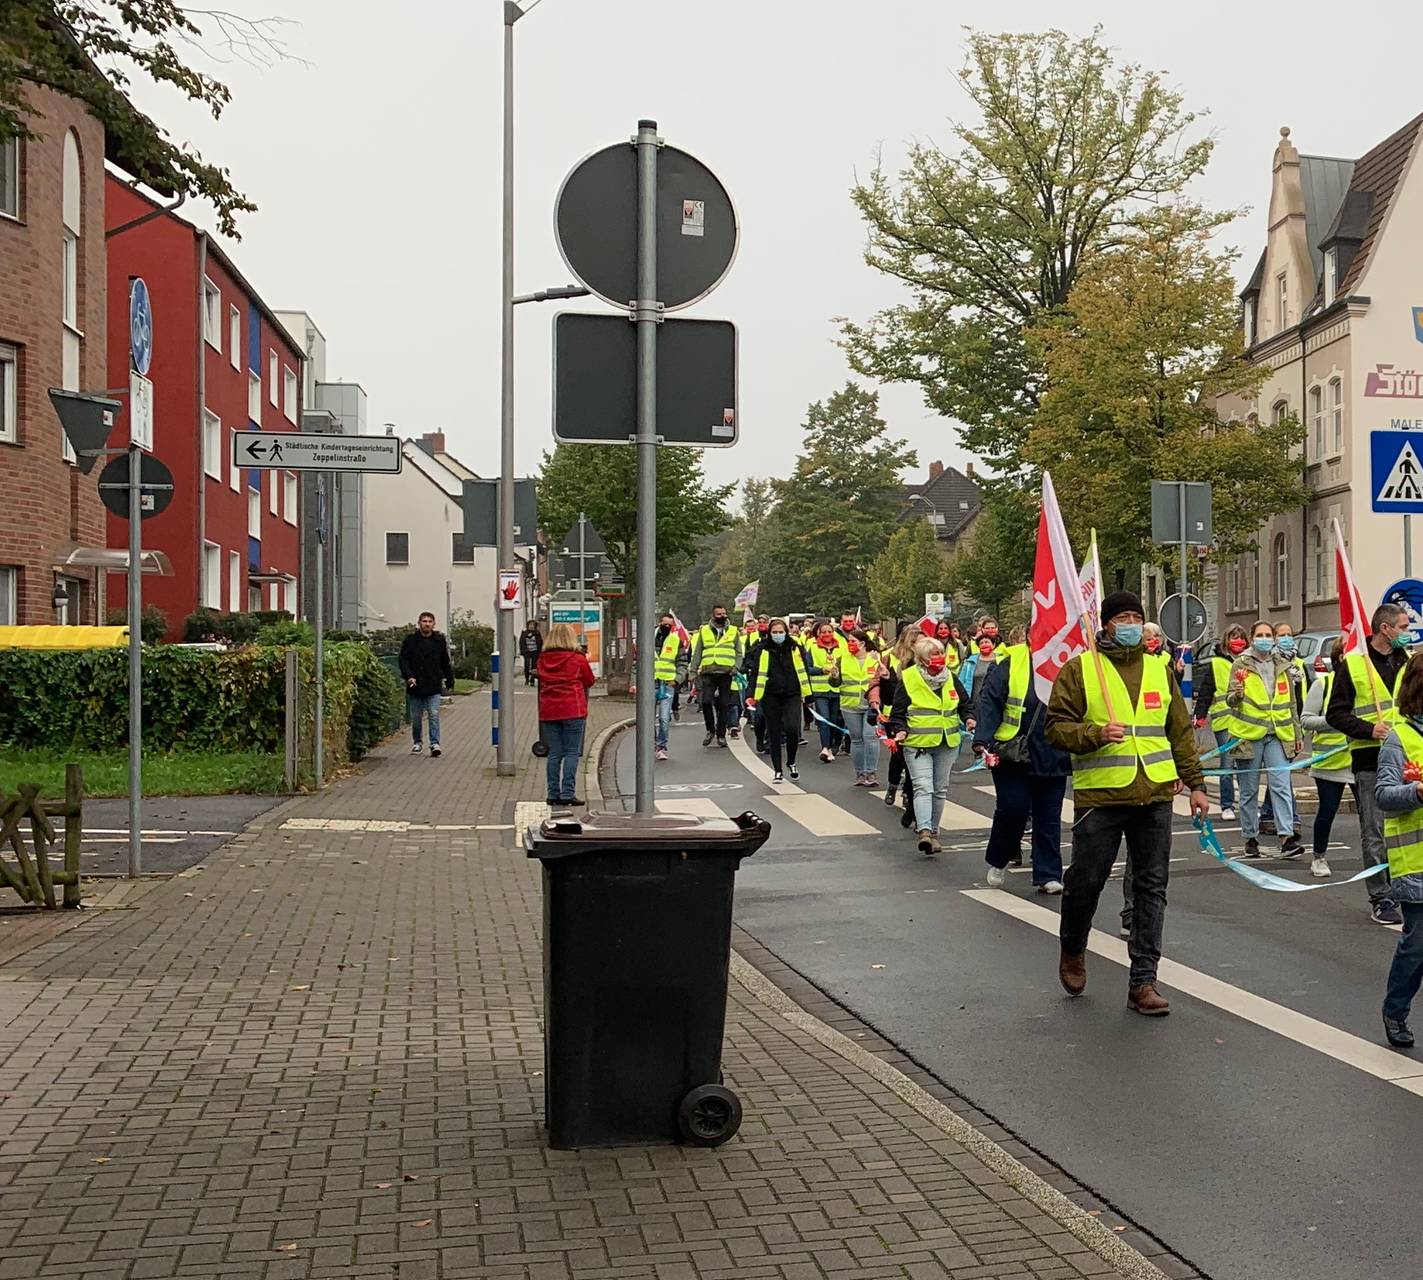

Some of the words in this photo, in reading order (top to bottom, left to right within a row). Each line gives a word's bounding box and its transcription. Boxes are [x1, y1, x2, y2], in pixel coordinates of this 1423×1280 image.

[285, 441, 318, 450] Städtische
[321, 443, 394, 453] Kindertageseinrichtung
[312, 453, 367, 463] Zeppelinstraße
